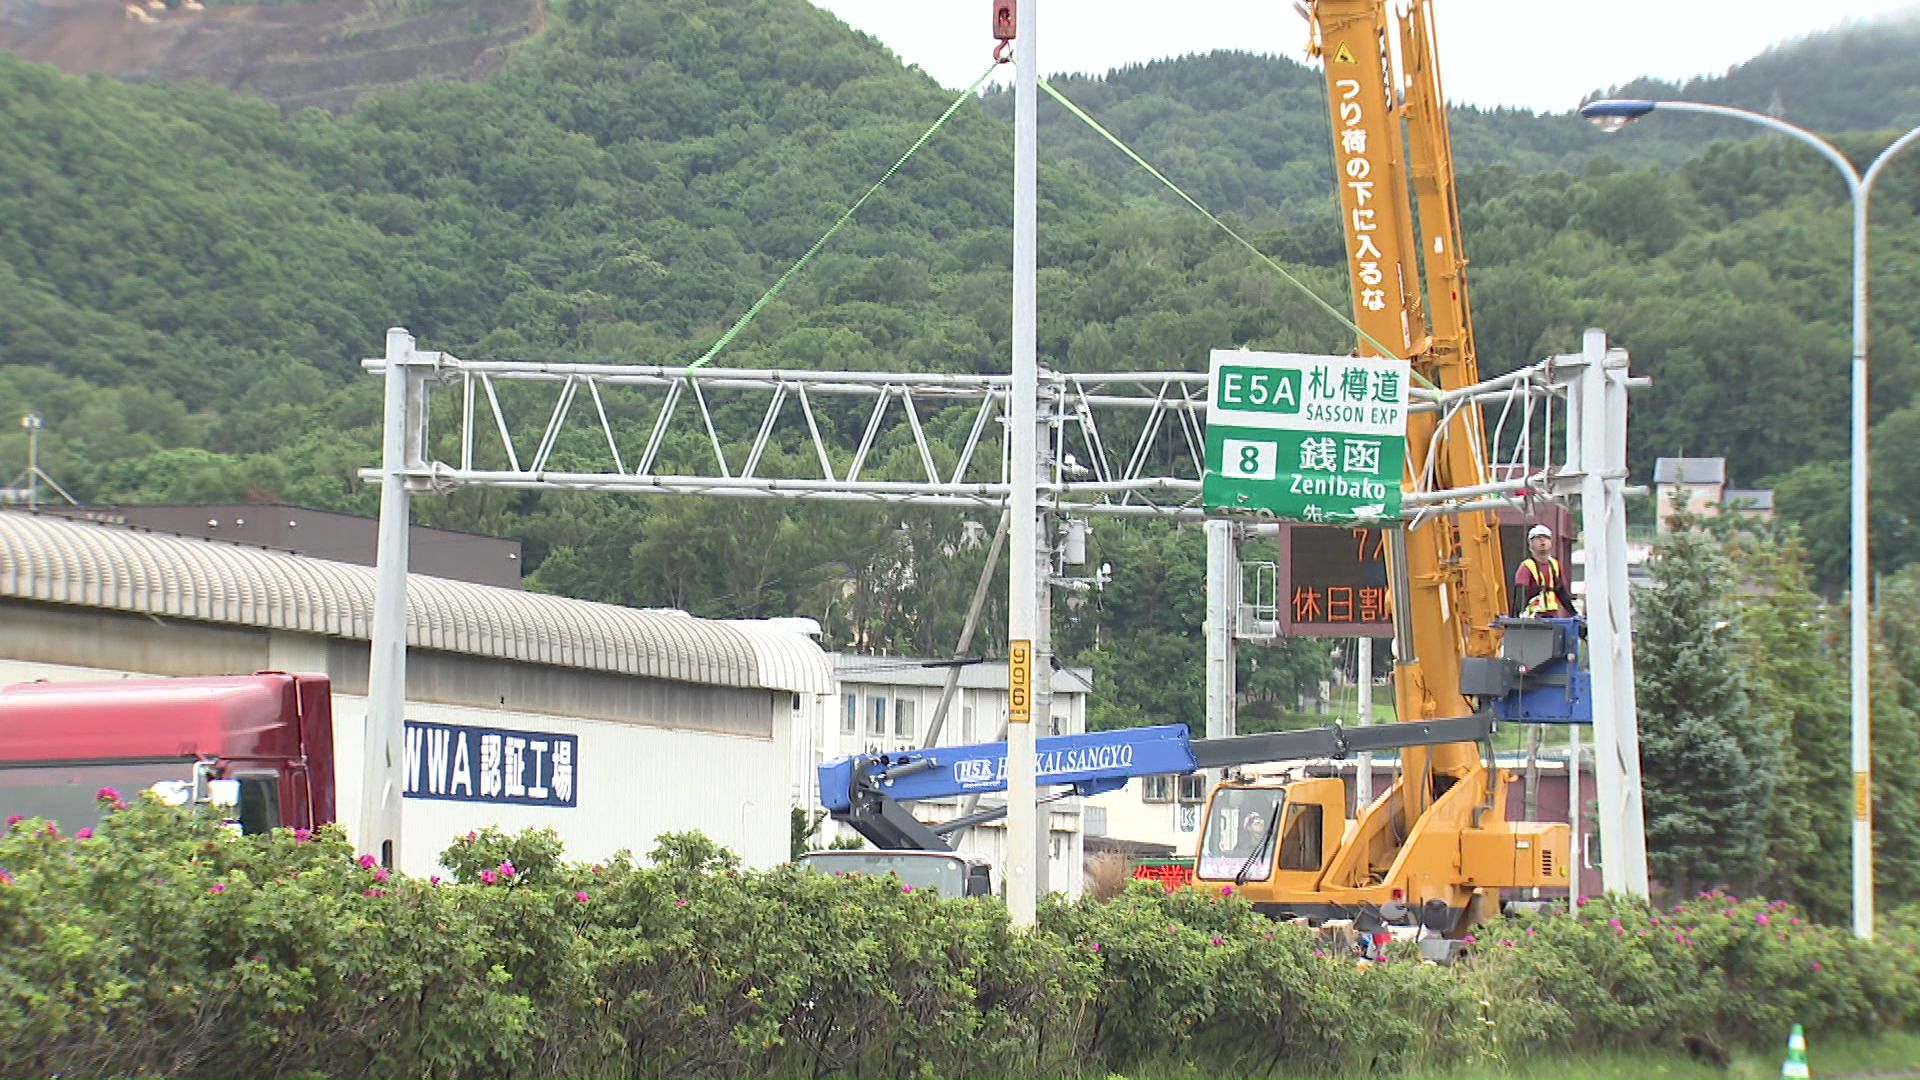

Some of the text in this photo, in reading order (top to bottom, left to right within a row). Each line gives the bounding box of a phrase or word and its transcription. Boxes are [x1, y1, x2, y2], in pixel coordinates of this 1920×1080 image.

[1336, 79, 1385, 312] つり荷の下に入るな
[1224, 373, 1295, 406] E5A
[1308, 365, 1400, 402] 札樽道
[1306, 403, 1398, 424] SASSON EXP
[1239, 445, 1260, 474] 8
[1299, 437, 1382, 474] 銭函
[1290, 474, 1386, 499] Zenibako
[1293, 586, 1389, 622] 休日割
